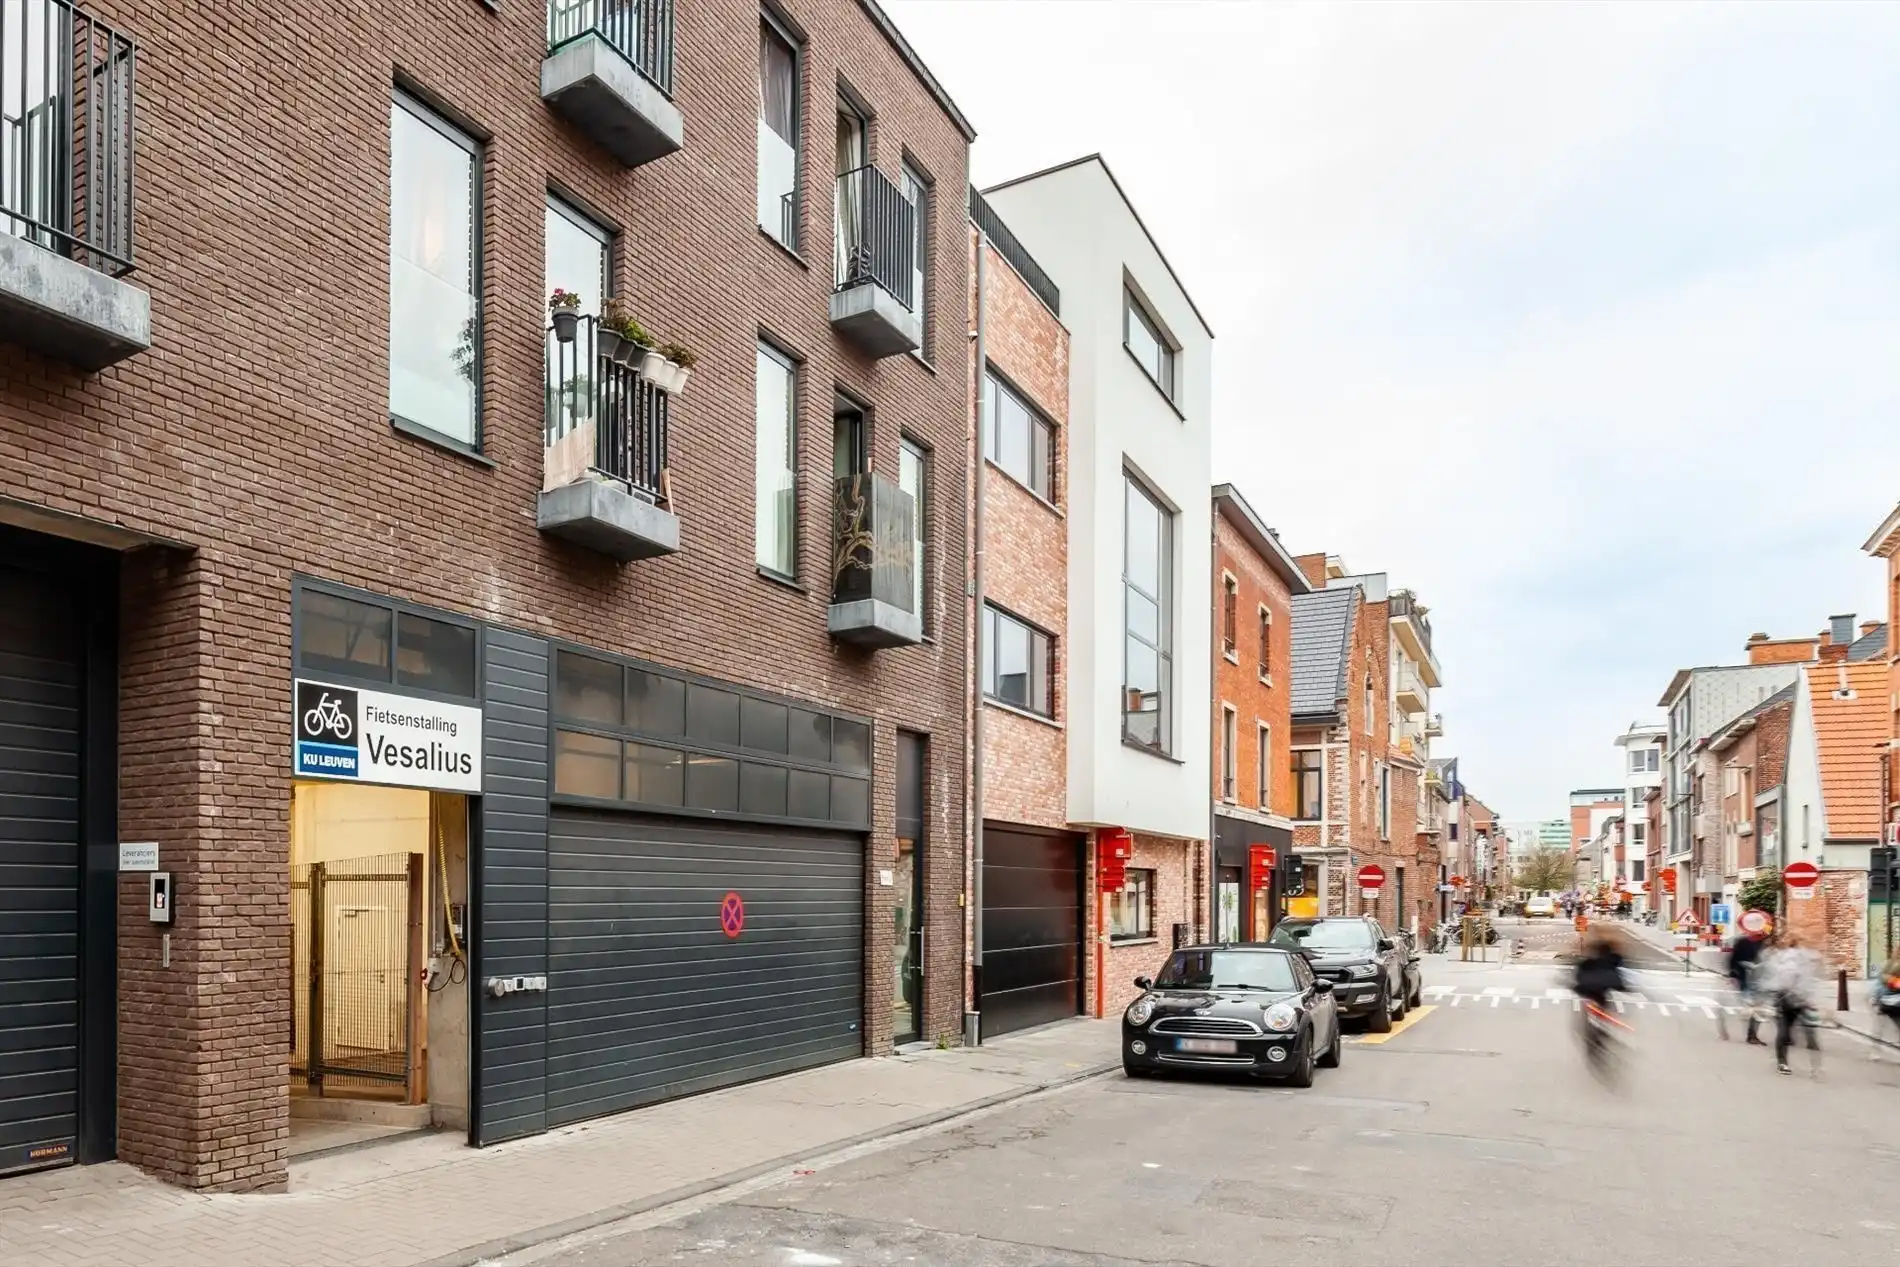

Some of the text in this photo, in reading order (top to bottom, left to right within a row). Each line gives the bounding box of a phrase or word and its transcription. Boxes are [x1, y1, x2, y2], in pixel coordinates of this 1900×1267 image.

[366, 706, 457, 737] Fietsenstalling
[303, 753, 356, 769] KU LEUVEN
[366, 733, 472, 774] Vesalius
